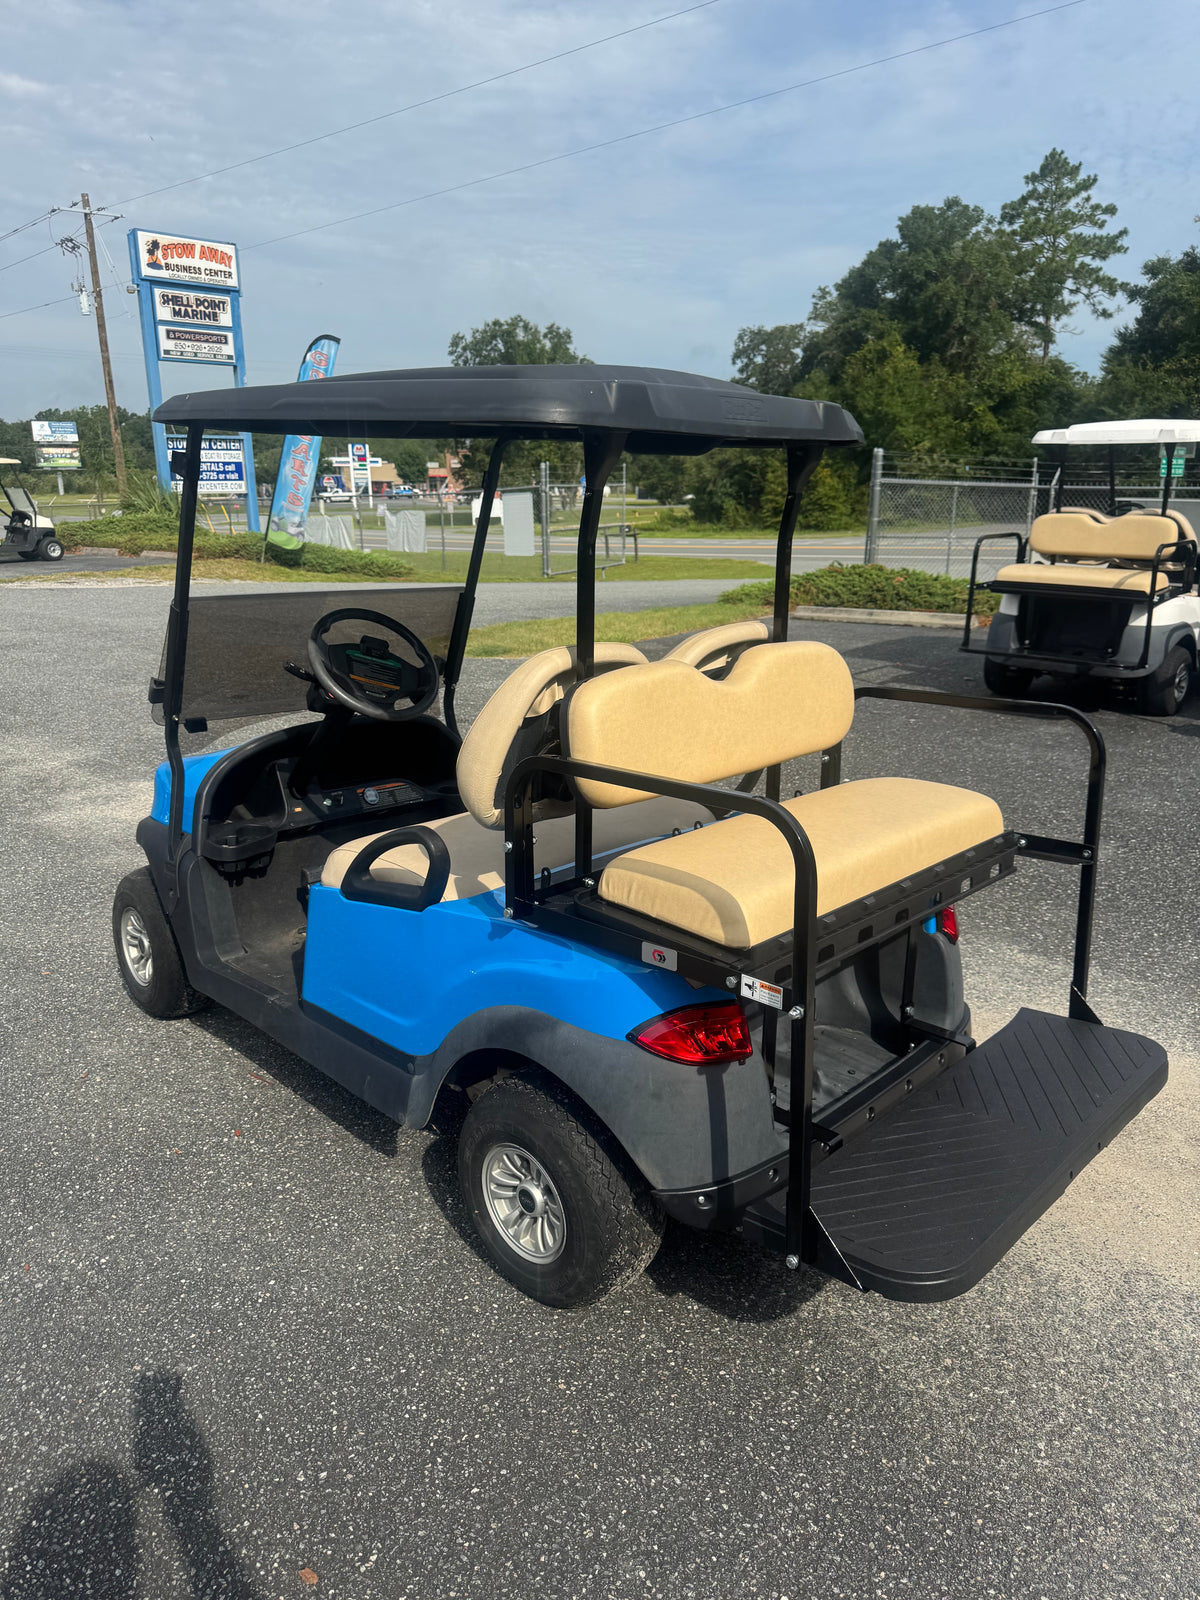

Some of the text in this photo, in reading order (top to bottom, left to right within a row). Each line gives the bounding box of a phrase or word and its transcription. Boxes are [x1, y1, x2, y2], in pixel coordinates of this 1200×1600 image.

[161, 242, 233, 269] STOW AWAY
[164, 262, 233, 280] BUSINESS CENTER
[161, 294, 227, 312] SHELL POINT
[172, 307, 218, 322] MARINE
[175, 332, 226, 343] POWERSPORTS
[211, 440, 241, 450] CENTER
[200, 462, 236, 472] ENTALS call
[226, 472, 239, 480] visit
